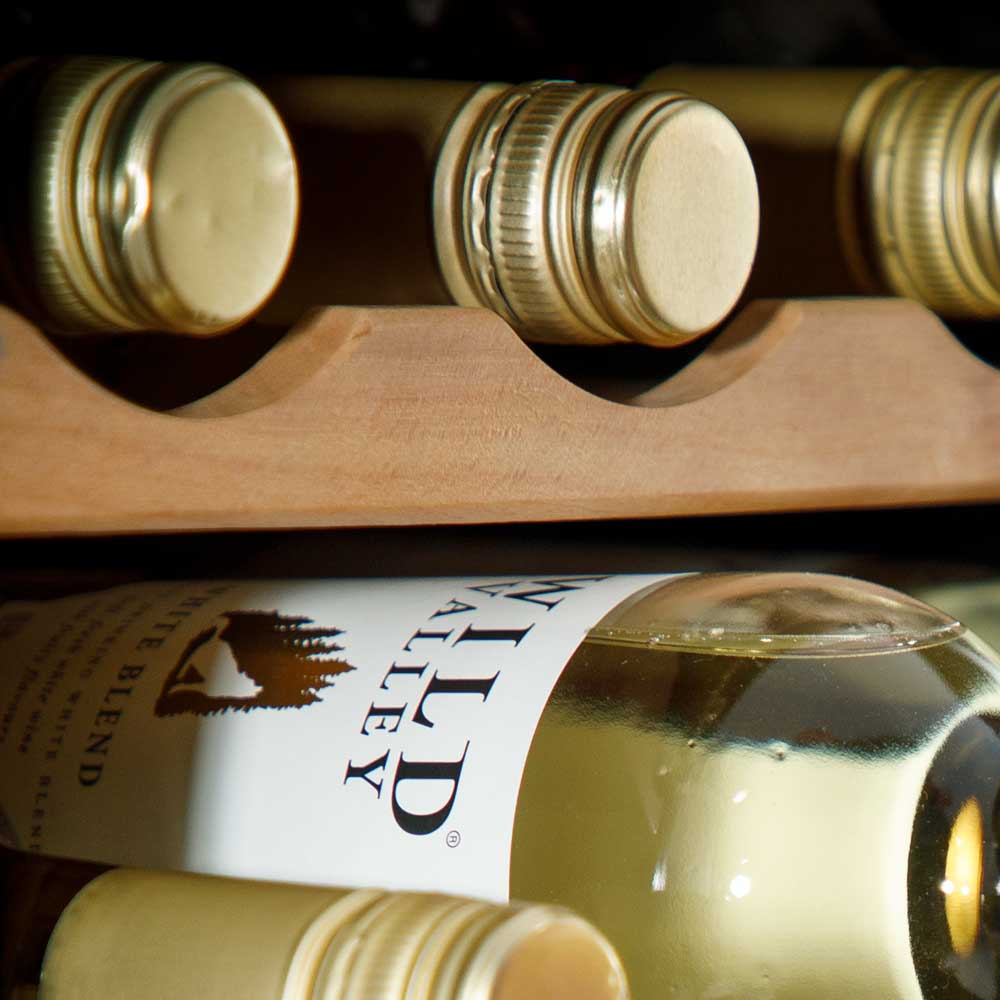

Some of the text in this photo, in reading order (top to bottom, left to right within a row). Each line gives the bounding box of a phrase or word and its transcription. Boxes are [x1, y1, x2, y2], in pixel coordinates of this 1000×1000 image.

[78, 663, 146, 787] BLEND
[343, 581, 523, 800] VALLEY
[391, 575, 613, 836] WILD
